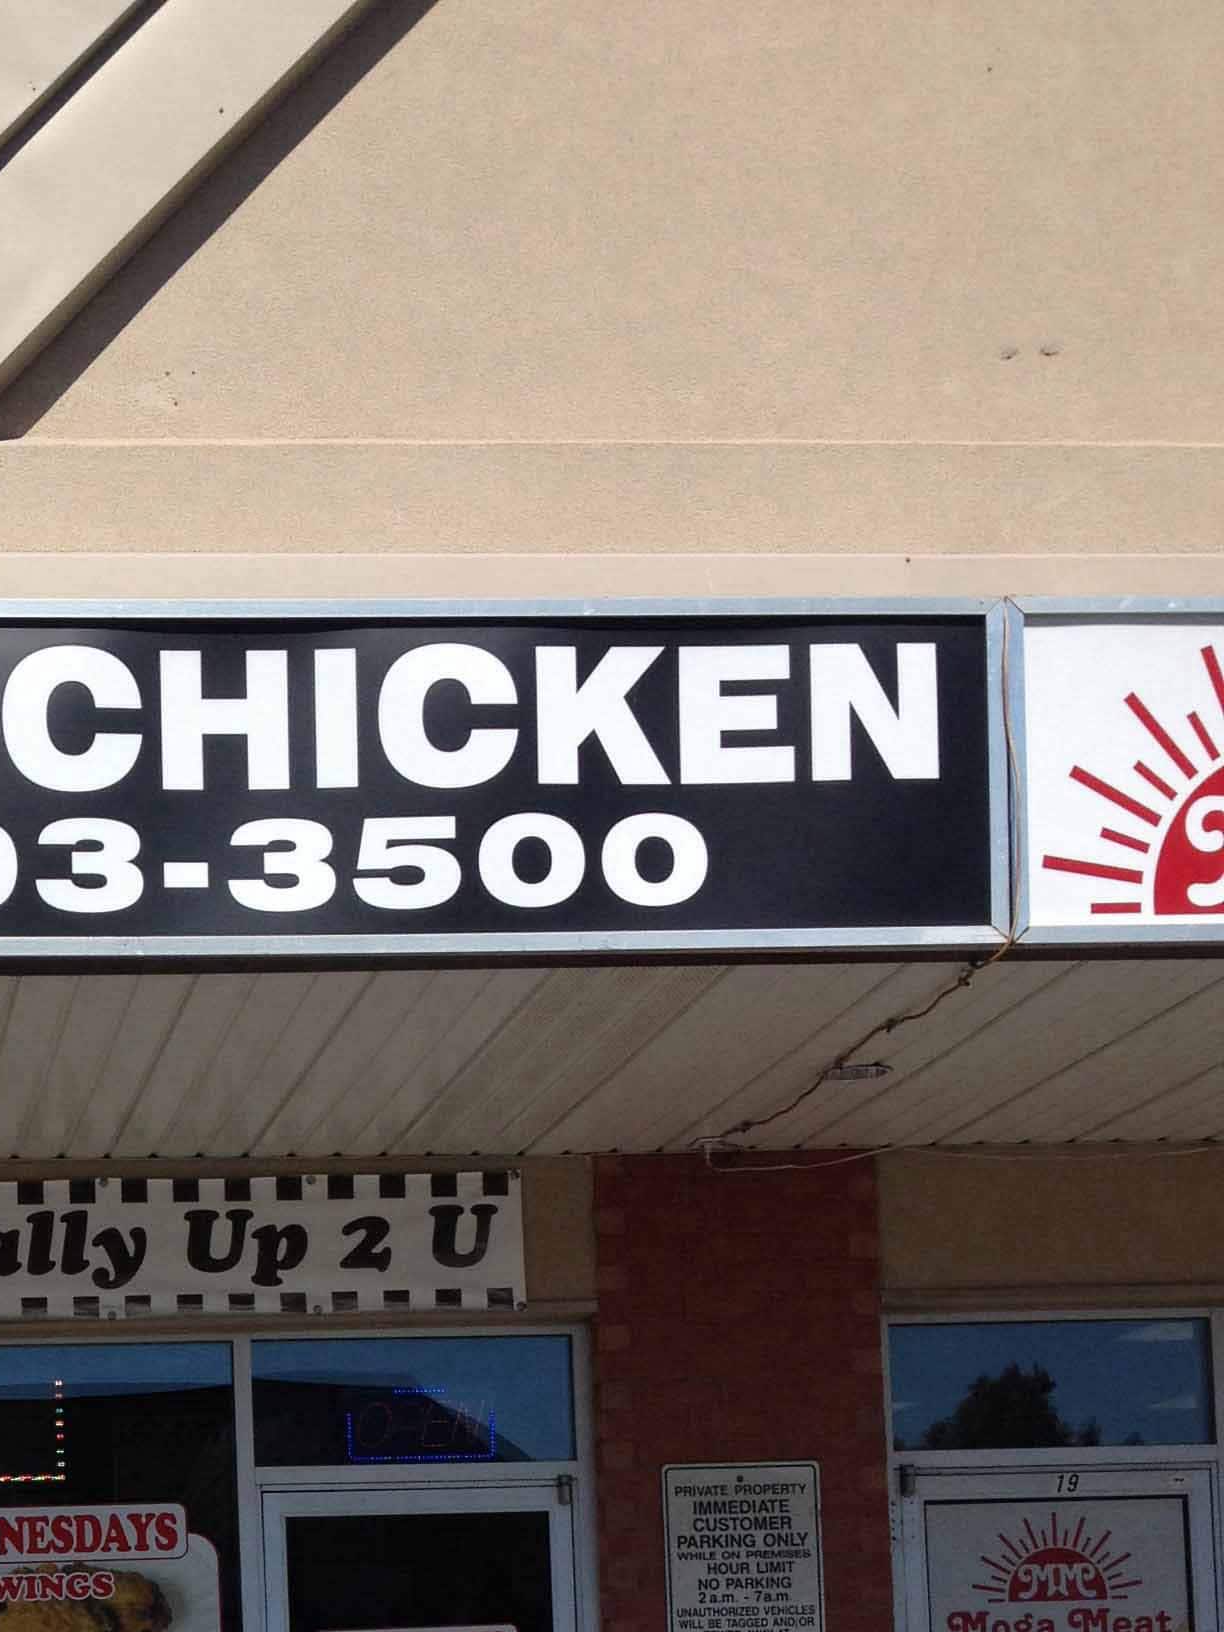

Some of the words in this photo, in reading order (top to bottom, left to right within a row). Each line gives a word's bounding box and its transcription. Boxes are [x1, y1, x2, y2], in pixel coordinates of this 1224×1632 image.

[1, 642, 940, 792] CHICKEN
[184, 1209, 309, 1287] Up
[339, 1216, 393, 1272] 2
[428, 1204, 499, 1268] U
[674, 1484, 728, 1497] PRIVATE
[734, 1483, 807, 1496] PROPERTY
[1056, 1473, 1080, 1493] 19
[693, 1499, 790, 1515] IMMEDIATE
[693, 1516, 792, 1532] CUSTOMER
[677, 1533, 756, 1549] PARKING
[763, 1532, 809, 1548] ONLY
[676, 1551, 717, 1561] WHILE
[721, 1551, 741, 1561] ON
[745, 1549, 812, 1560] PREMISES
[707, 1562, 750, 1575] HOUR
[756, 1561, 795, 1573] LIMIT
[698, 1578, 720, 1591] NO
[726, 1576, 792, 1589] PARKING
[677, 1606, 760, 1618] UNAUTHORIZED
[763, 1605, 816, 1616] VEHICLES
[678, 1619, 704, 1630] WILL
[707, 1618, 722, 1629] BE
[726, 1617, 769, 1628] TAGGED
